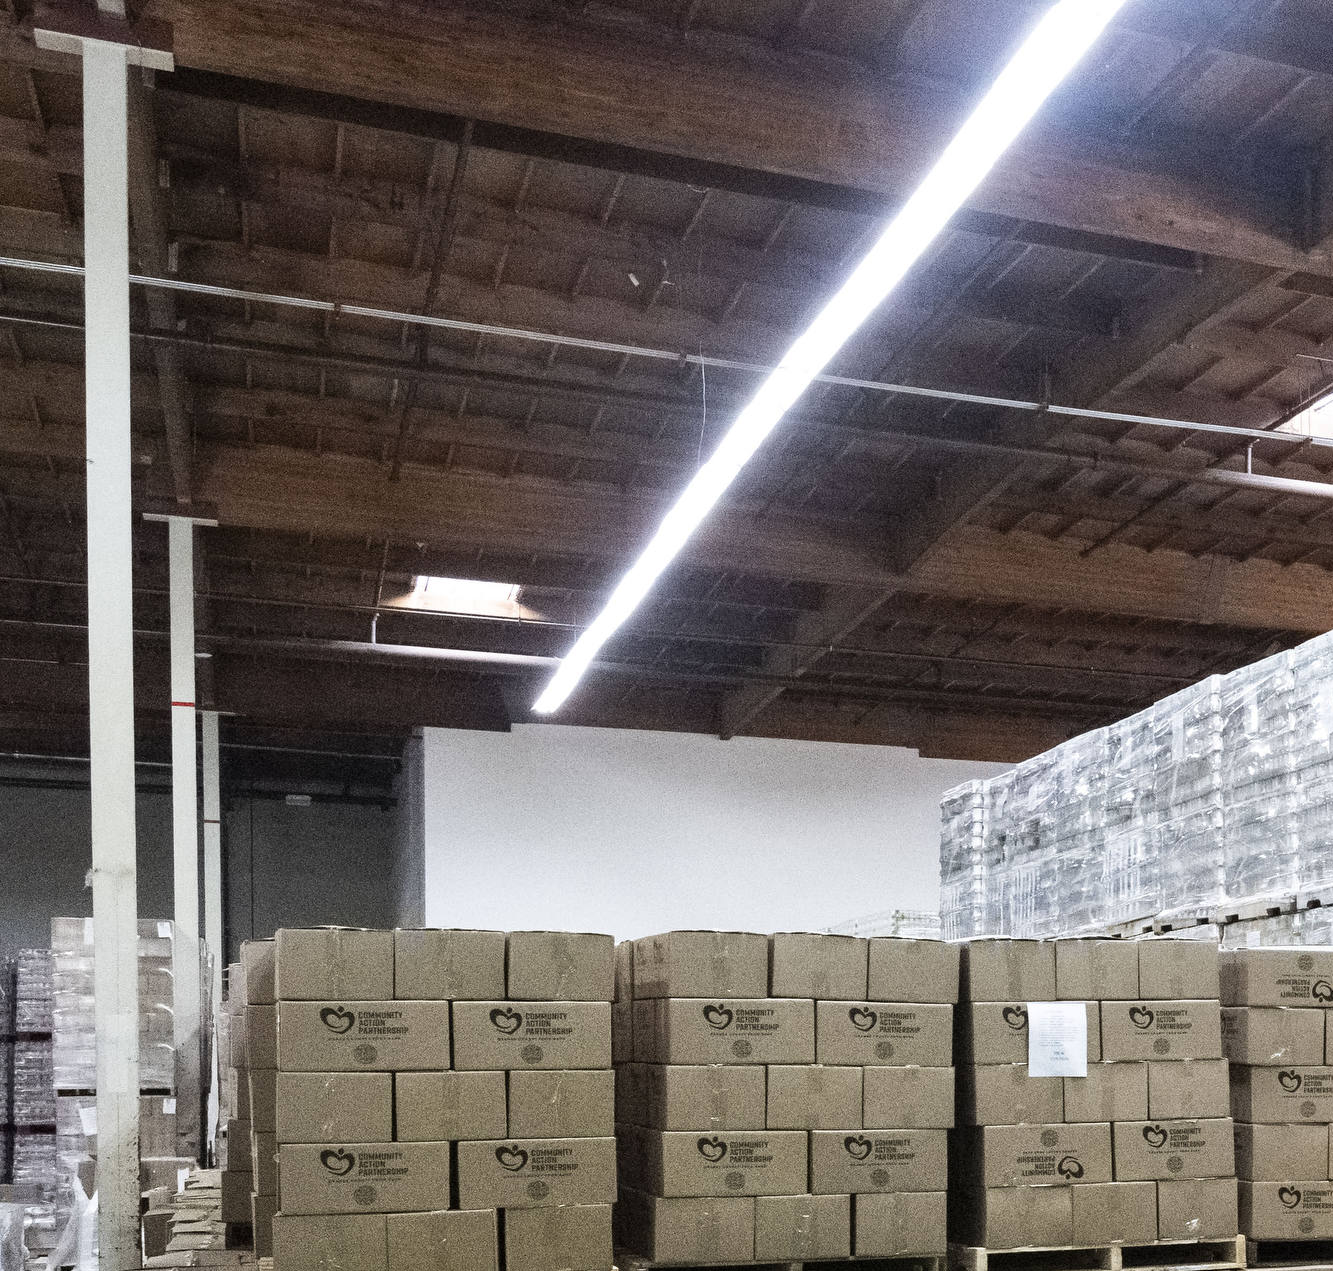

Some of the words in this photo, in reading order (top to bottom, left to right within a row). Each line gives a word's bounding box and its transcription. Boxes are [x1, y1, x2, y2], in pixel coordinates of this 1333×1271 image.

[879, 1025, 920, 1033] PARTNERSHIP
[358, 1152, 402, 1160] COMMUNITY
[531, 1148, 572, 1156] COMMUNITY
[358, 1167, 408, 1175] PARTNERSHIP
[531, 1163, 578, 1171] PARTNERSHIP
